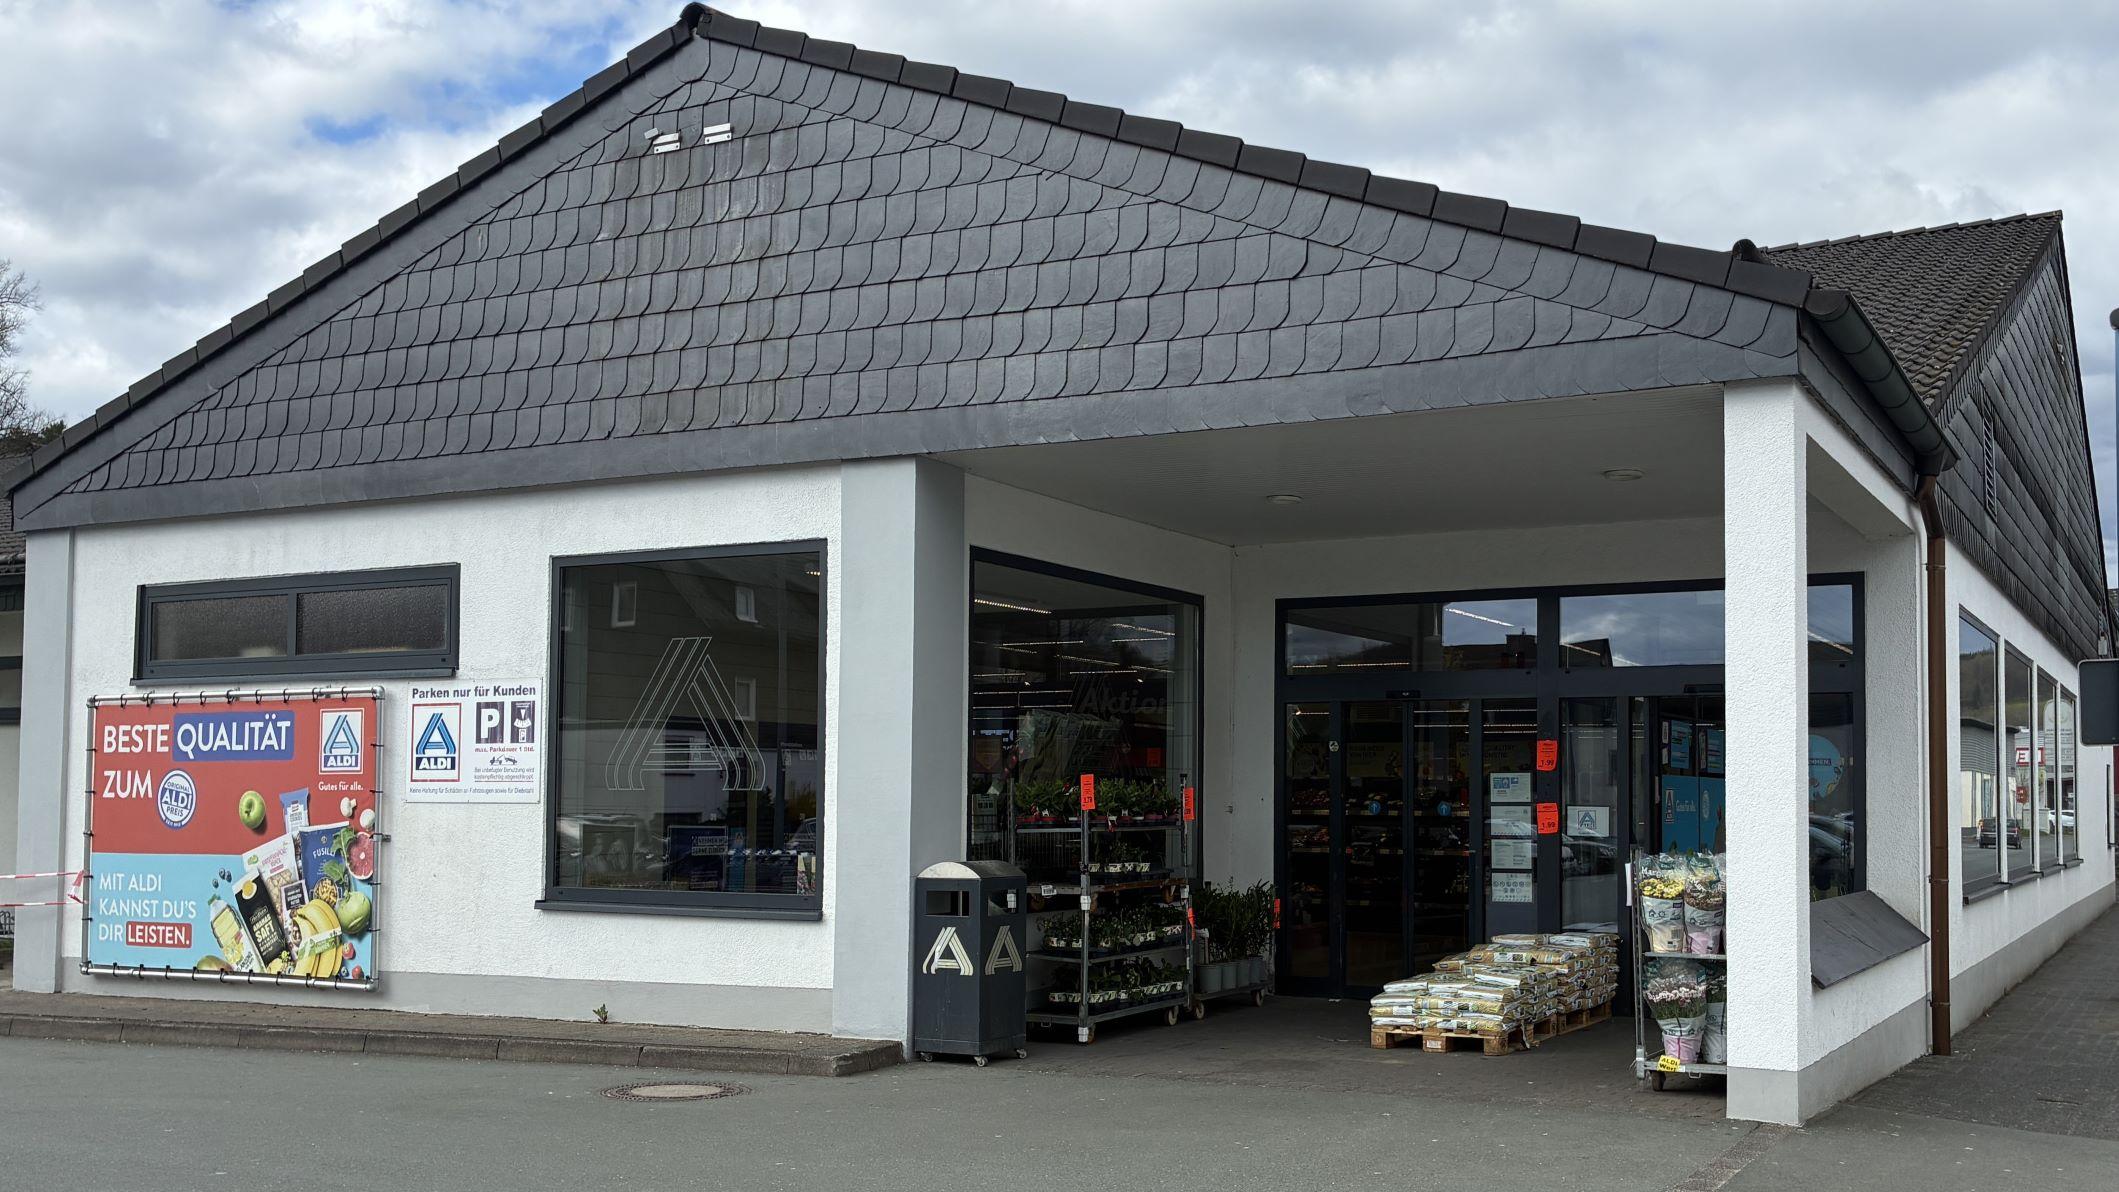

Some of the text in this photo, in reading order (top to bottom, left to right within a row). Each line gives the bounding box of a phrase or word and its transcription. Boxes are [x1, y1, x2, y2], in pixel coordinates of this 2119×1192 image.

[412, 685, 536, 699] Parken nur für Kunden
[480, 708, 500, 739] P
[103, 713, 291, 759] BESTE QUALITÄT
[326, 755, 356, 767] ALDI
[419, 757, 452, 770] ALDI
[102, 769, 153, 799] ZUM
[318, 781, 364, 791] Gutes für alle.
[162, 789, 192, 810] ALDI
[166, 806, 184, 817] PREIS
[99, 873, 162, 892] MIT ALDI
[99, 898, 159, 918] KANNST
[99, 923, 190, 945] DIR LEISTEN.
[255, 920, 275, 943] SAFT
